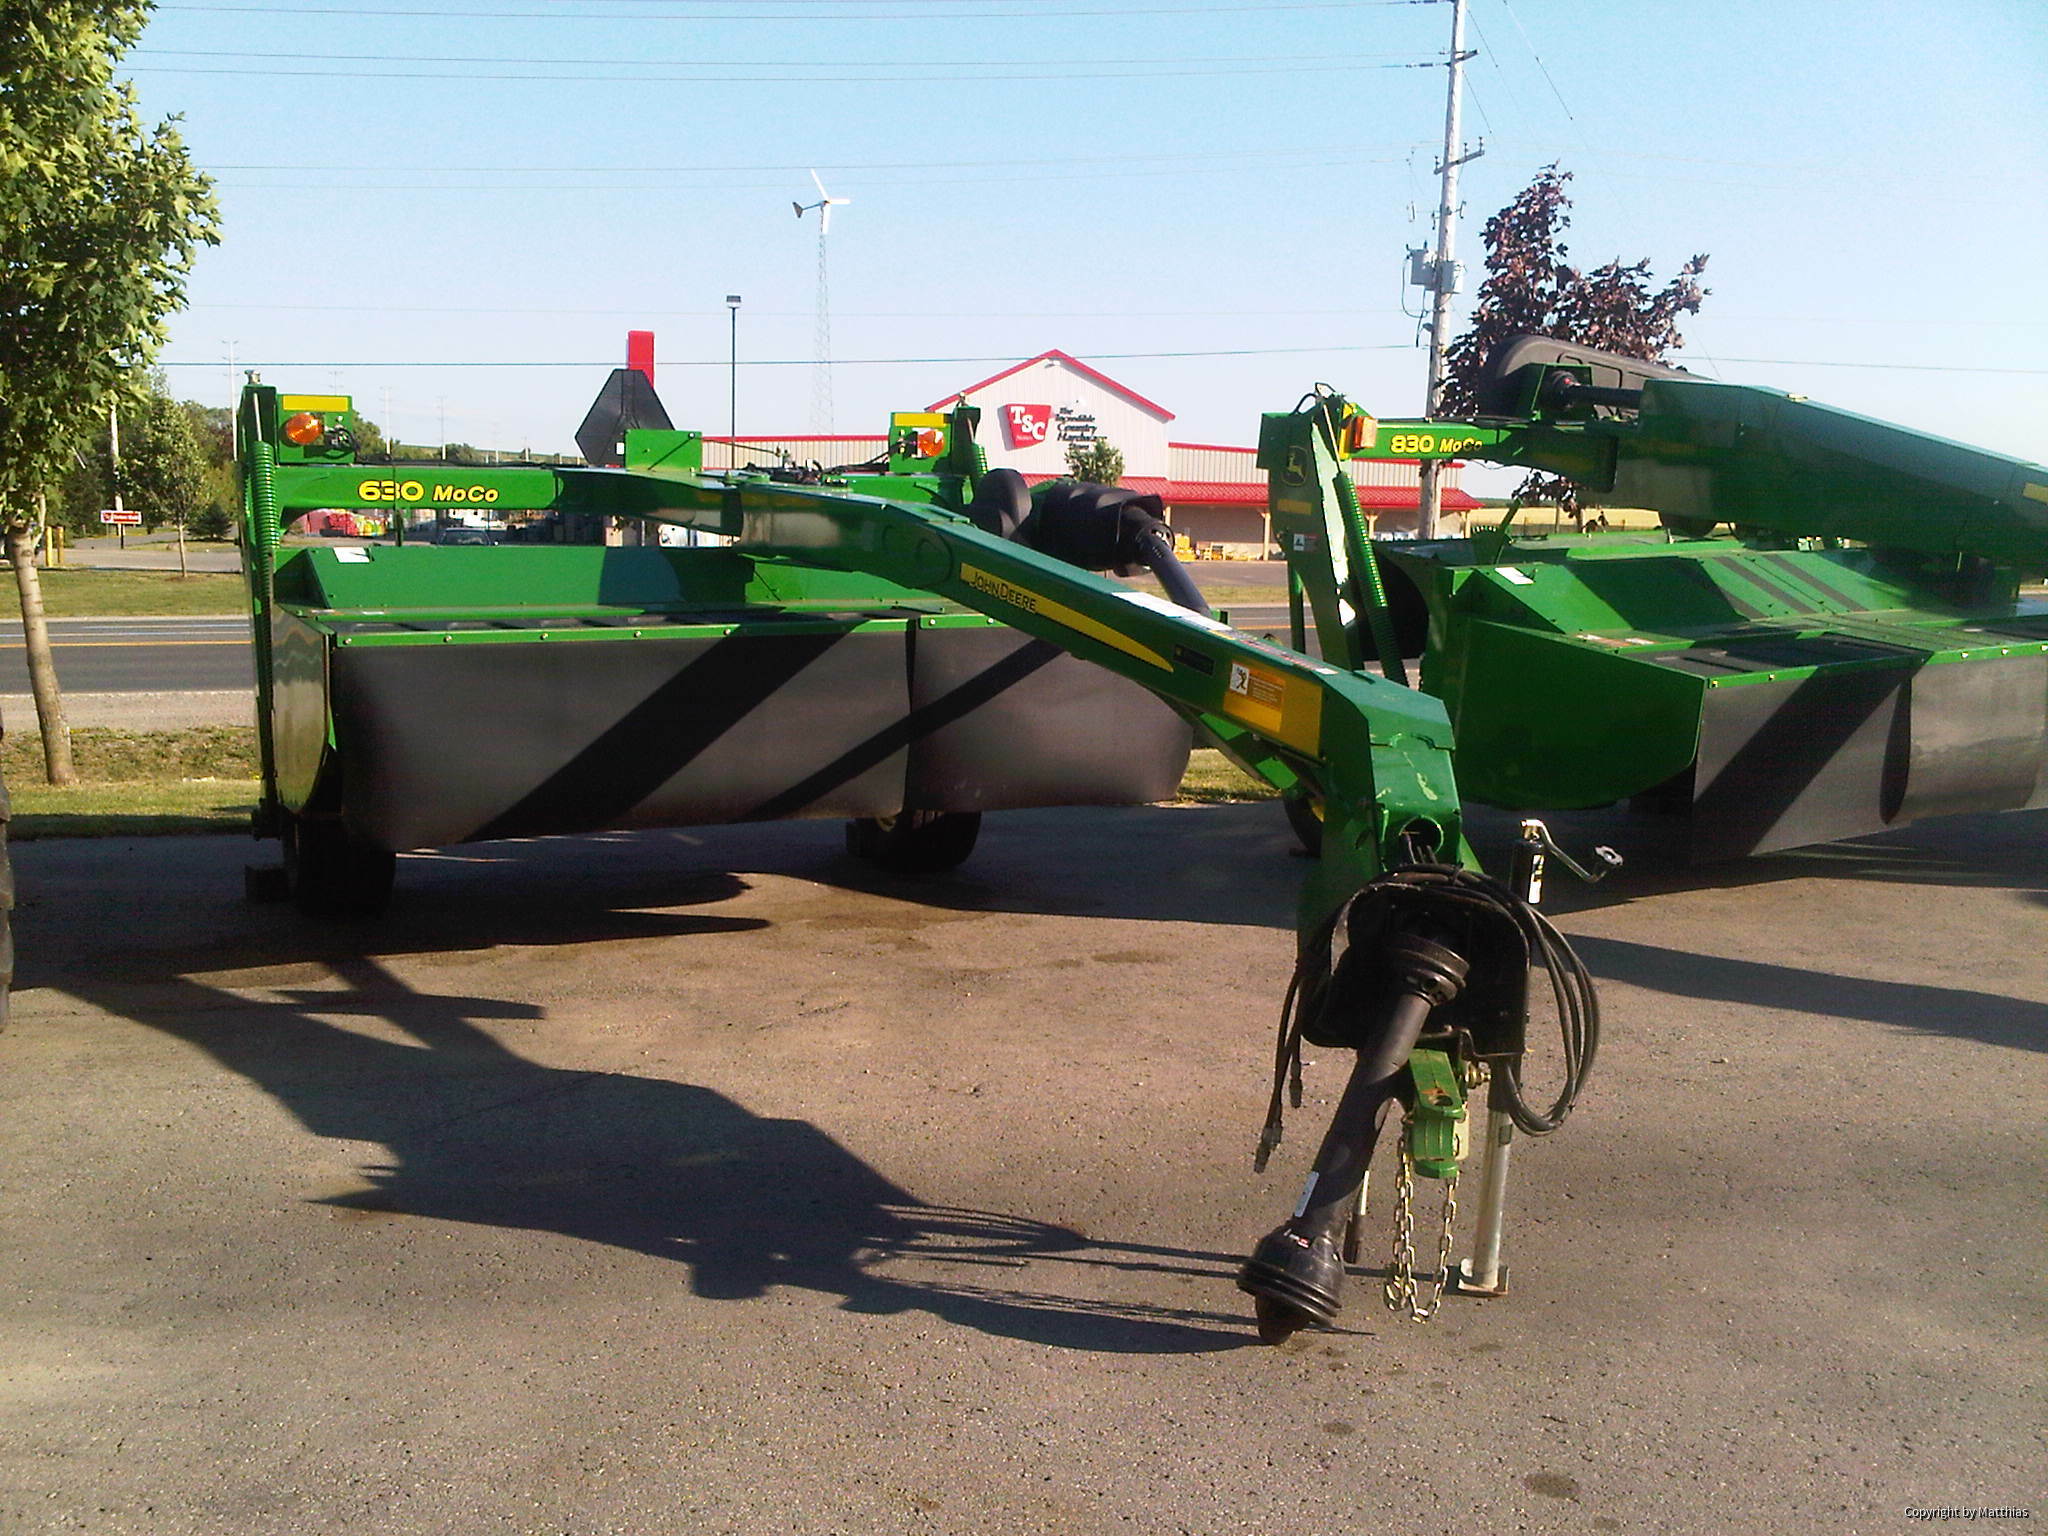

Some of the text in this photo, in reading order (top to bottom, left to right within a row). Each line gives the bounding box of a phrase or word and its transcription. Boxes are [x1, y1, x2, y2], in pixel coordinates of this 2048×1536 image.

[1010, 406, 1046, 440] TSC
[1390, 433, 1483, 453] 830 MoCo
[358, 480, 499, 502] 630 MoCo
